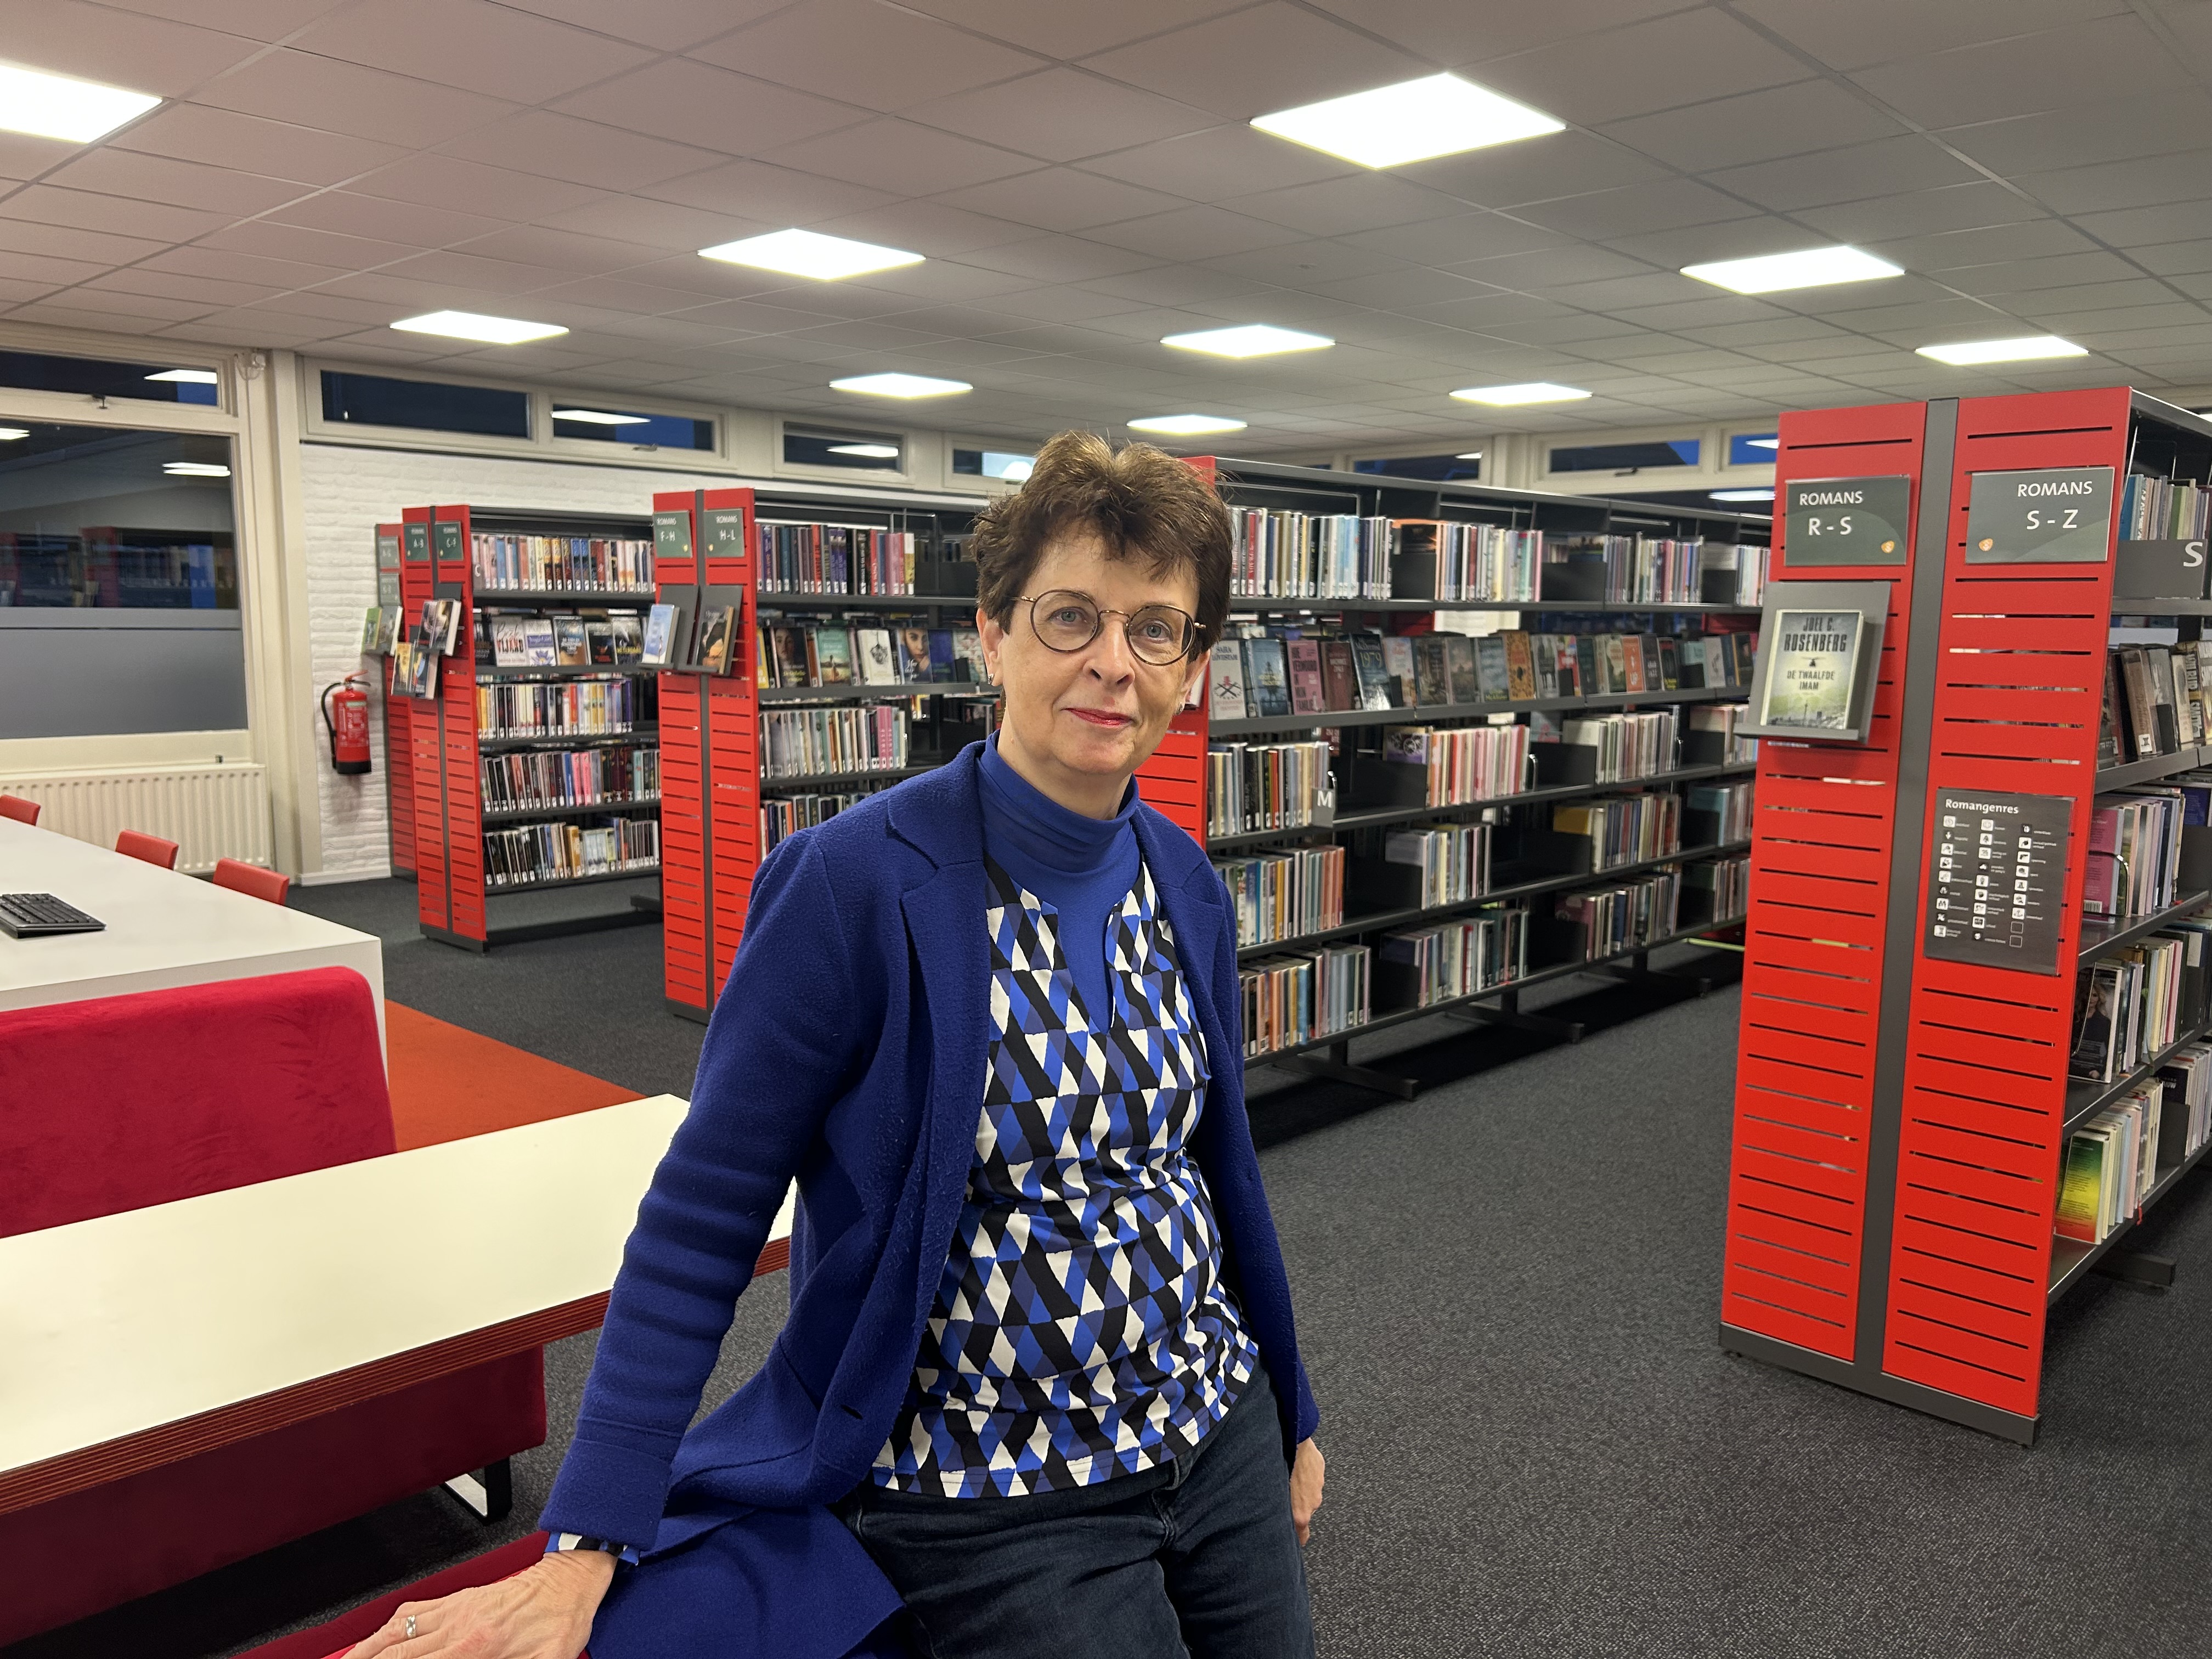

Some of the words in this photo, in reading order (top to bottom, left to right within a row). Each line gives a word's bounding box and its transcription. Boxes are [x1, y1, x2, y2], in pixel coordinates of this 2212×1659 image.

[2017, 481, 2093, 497] ROMANS
[1799, 490, 1864, 506] ROMANS
[1808, 517, 1821, 535] R
[1839, 516, 1852, 535] S
[2026, 510, 2040, 530] S
[2062, 509, 2078, 529] Z
[2183, 541, 2203, 567] S
[474, 562, 481, 577] C
[1803, 617, 1824, 631] JOEL
[1827, 616, 1835, 631] C.
[1784, 633, 1848, 652] ROSENBERG
[1359, 651, 1383, 668] 1979
[1787, 670, 1796, 680] DE
[1798, 670, 1836, 680] TWAALFDE
[1799, 681, 1819, 691] IMAM
[1317, 790, 1333, 808] M
[1945, 798, 2019, 814] Romangenres
